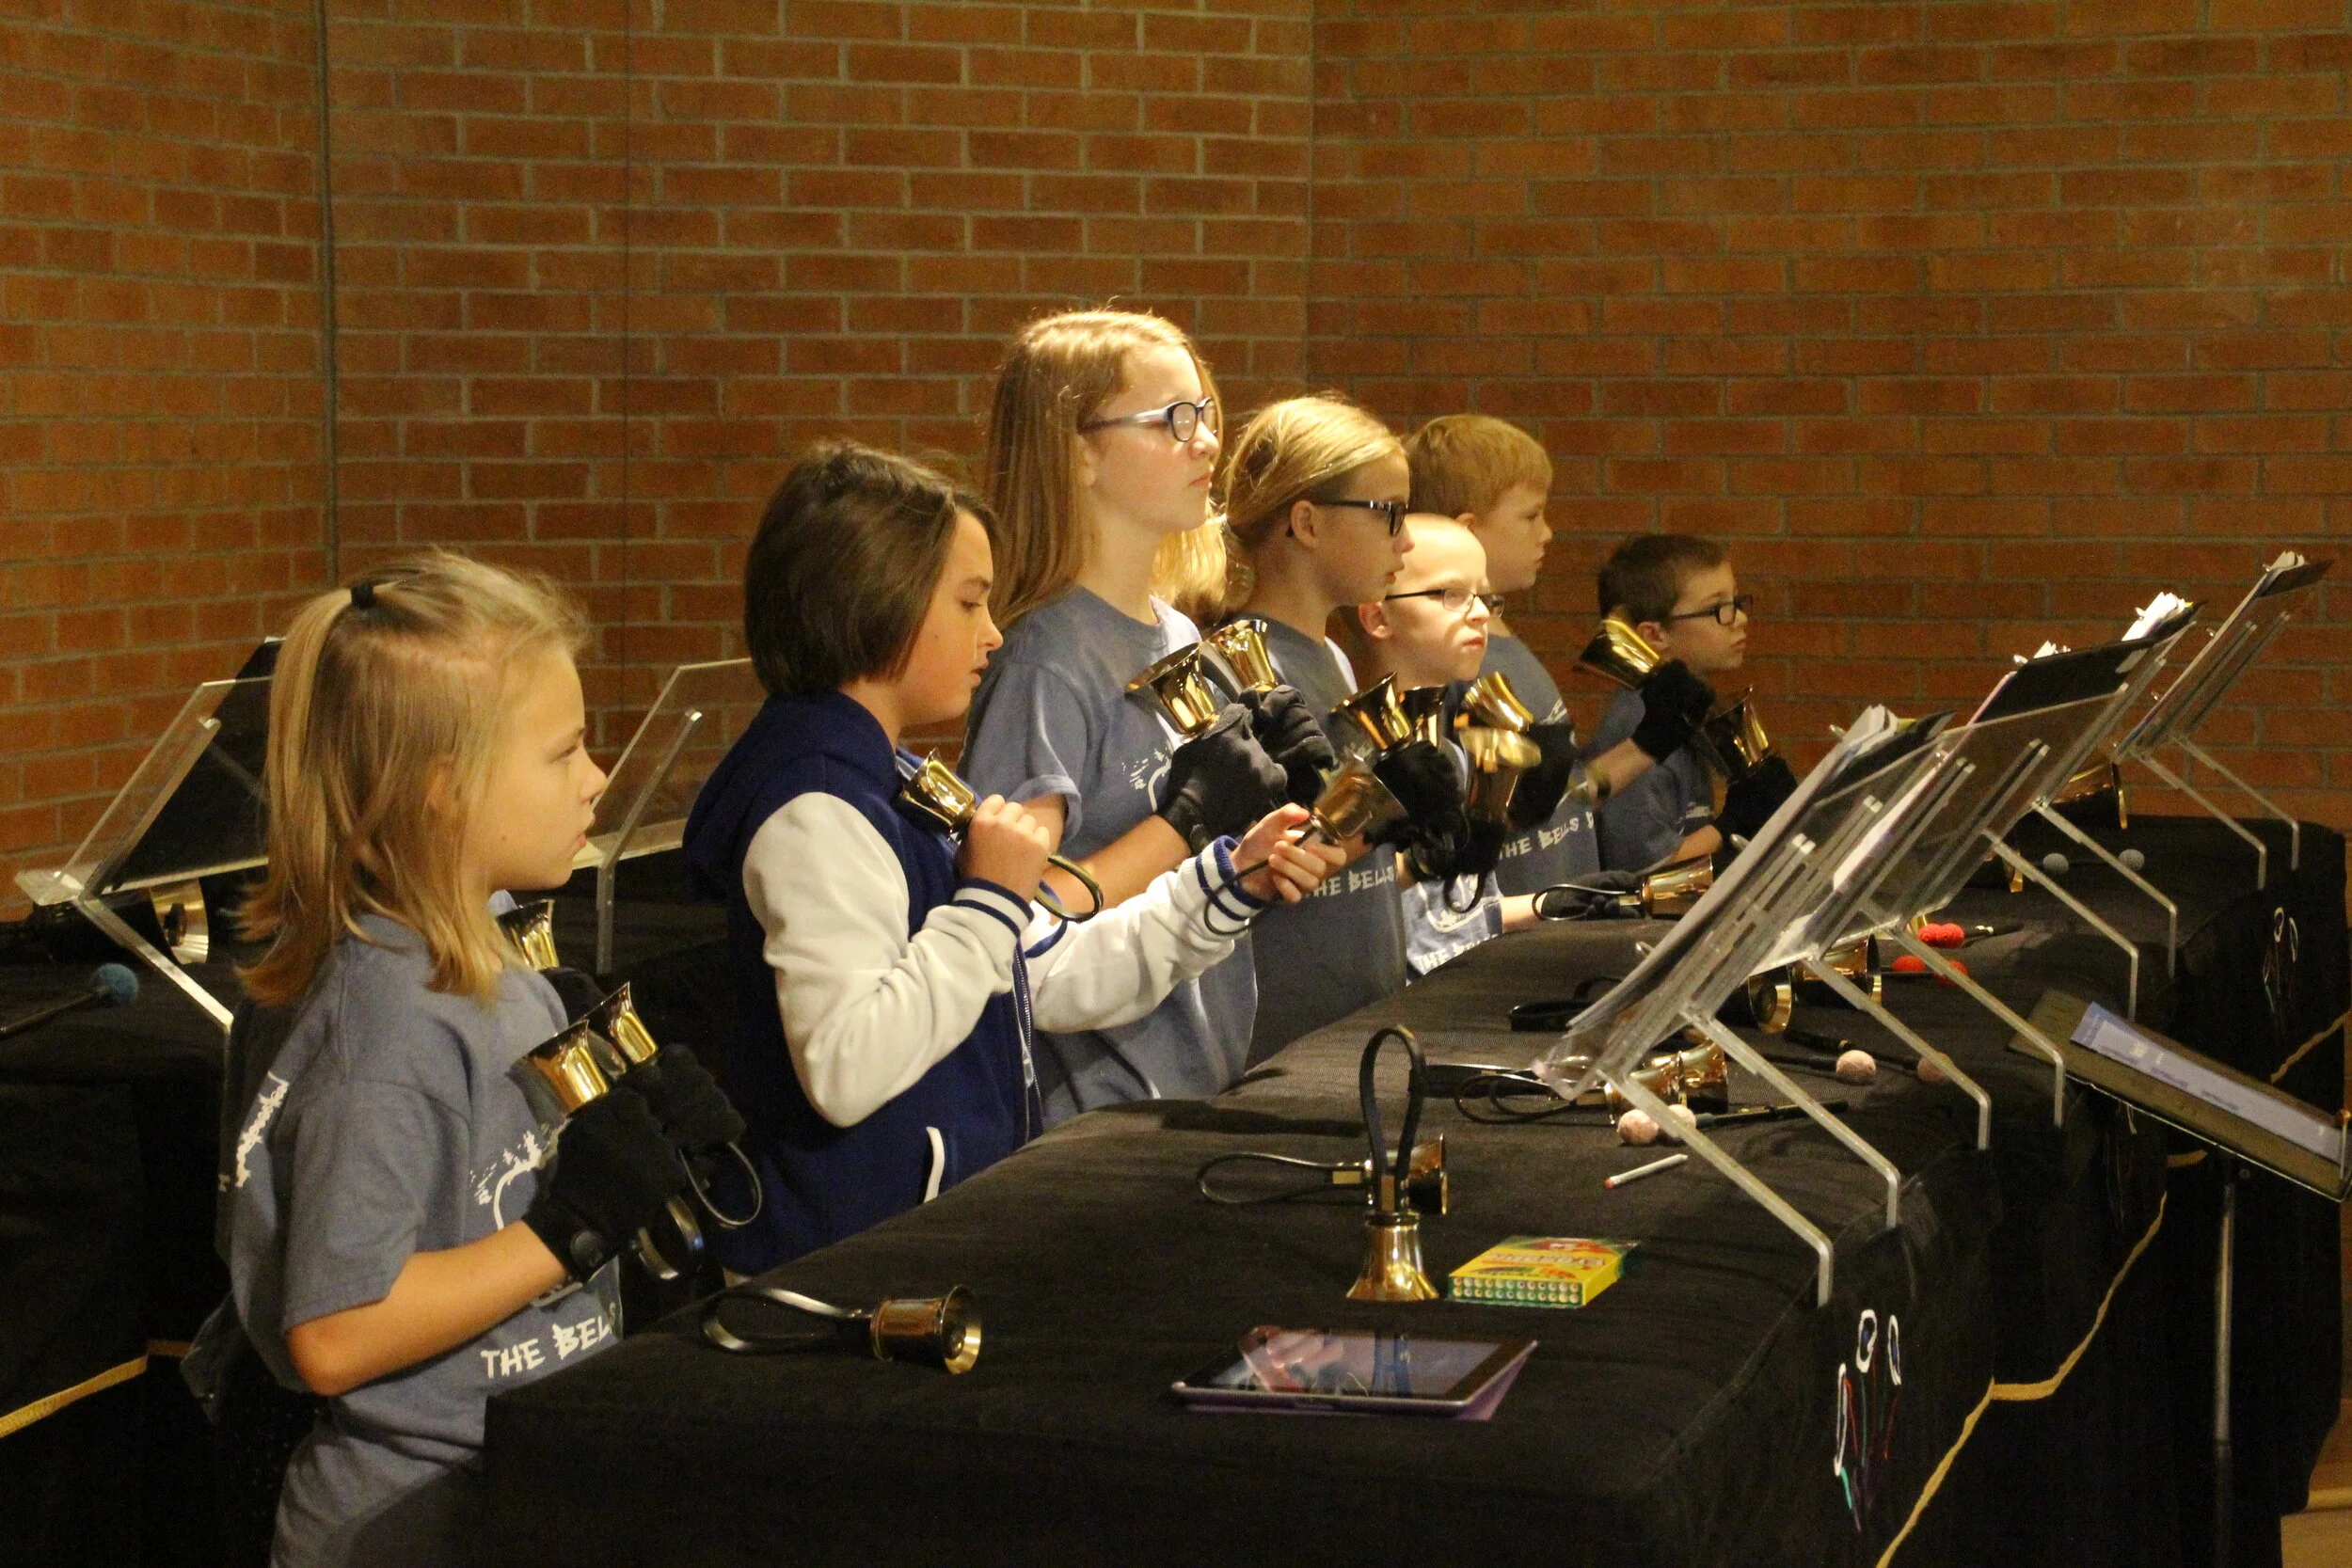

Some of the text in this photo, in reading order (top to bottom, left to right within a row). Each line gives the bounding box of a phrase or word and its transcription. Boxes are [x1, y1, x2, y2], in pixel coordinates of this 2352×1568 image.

[1538, 817, 1580, 849] BELLS
[1306, 865, 1394, 898] HE BELLS
[481, 1302, 616, 1379] THE BELS
